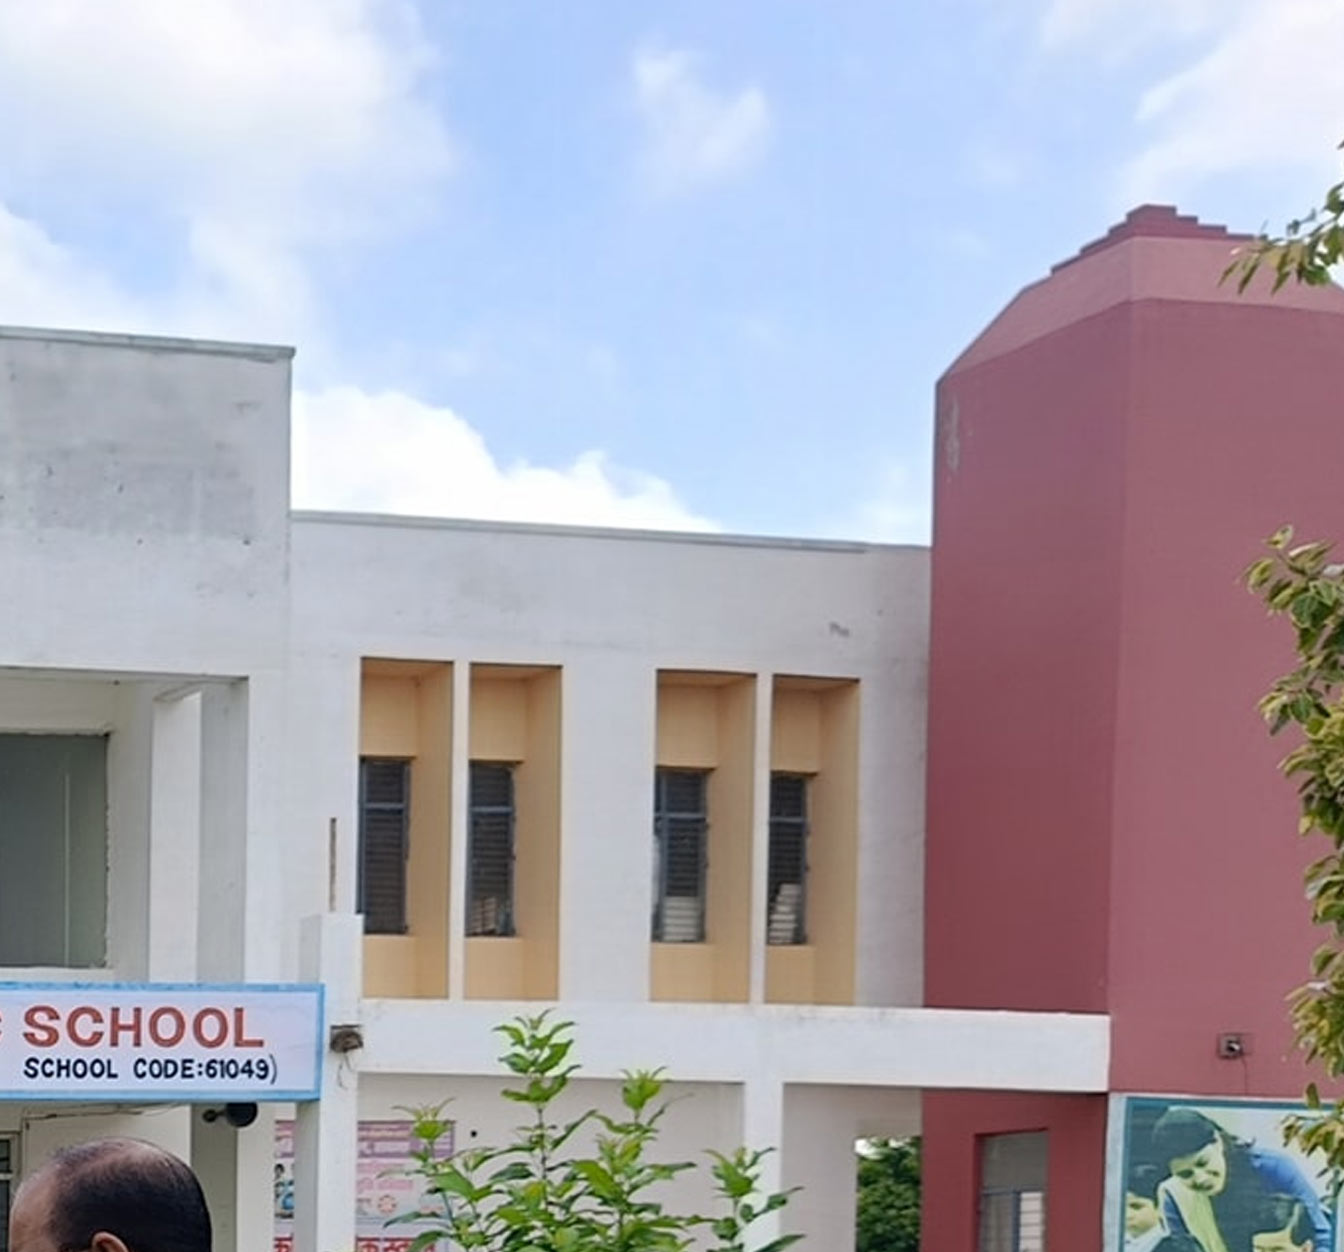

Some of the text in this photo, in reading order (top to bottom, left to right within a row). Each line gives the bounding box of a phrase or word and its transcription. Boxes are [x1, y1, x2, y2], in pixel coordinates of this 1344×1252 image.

[23, 1004, 264, 1049] SCHOOL
[23, 1057, 119, 1079] SCHOOL
[133, 1054, 278, 1085] CODE:61049)
